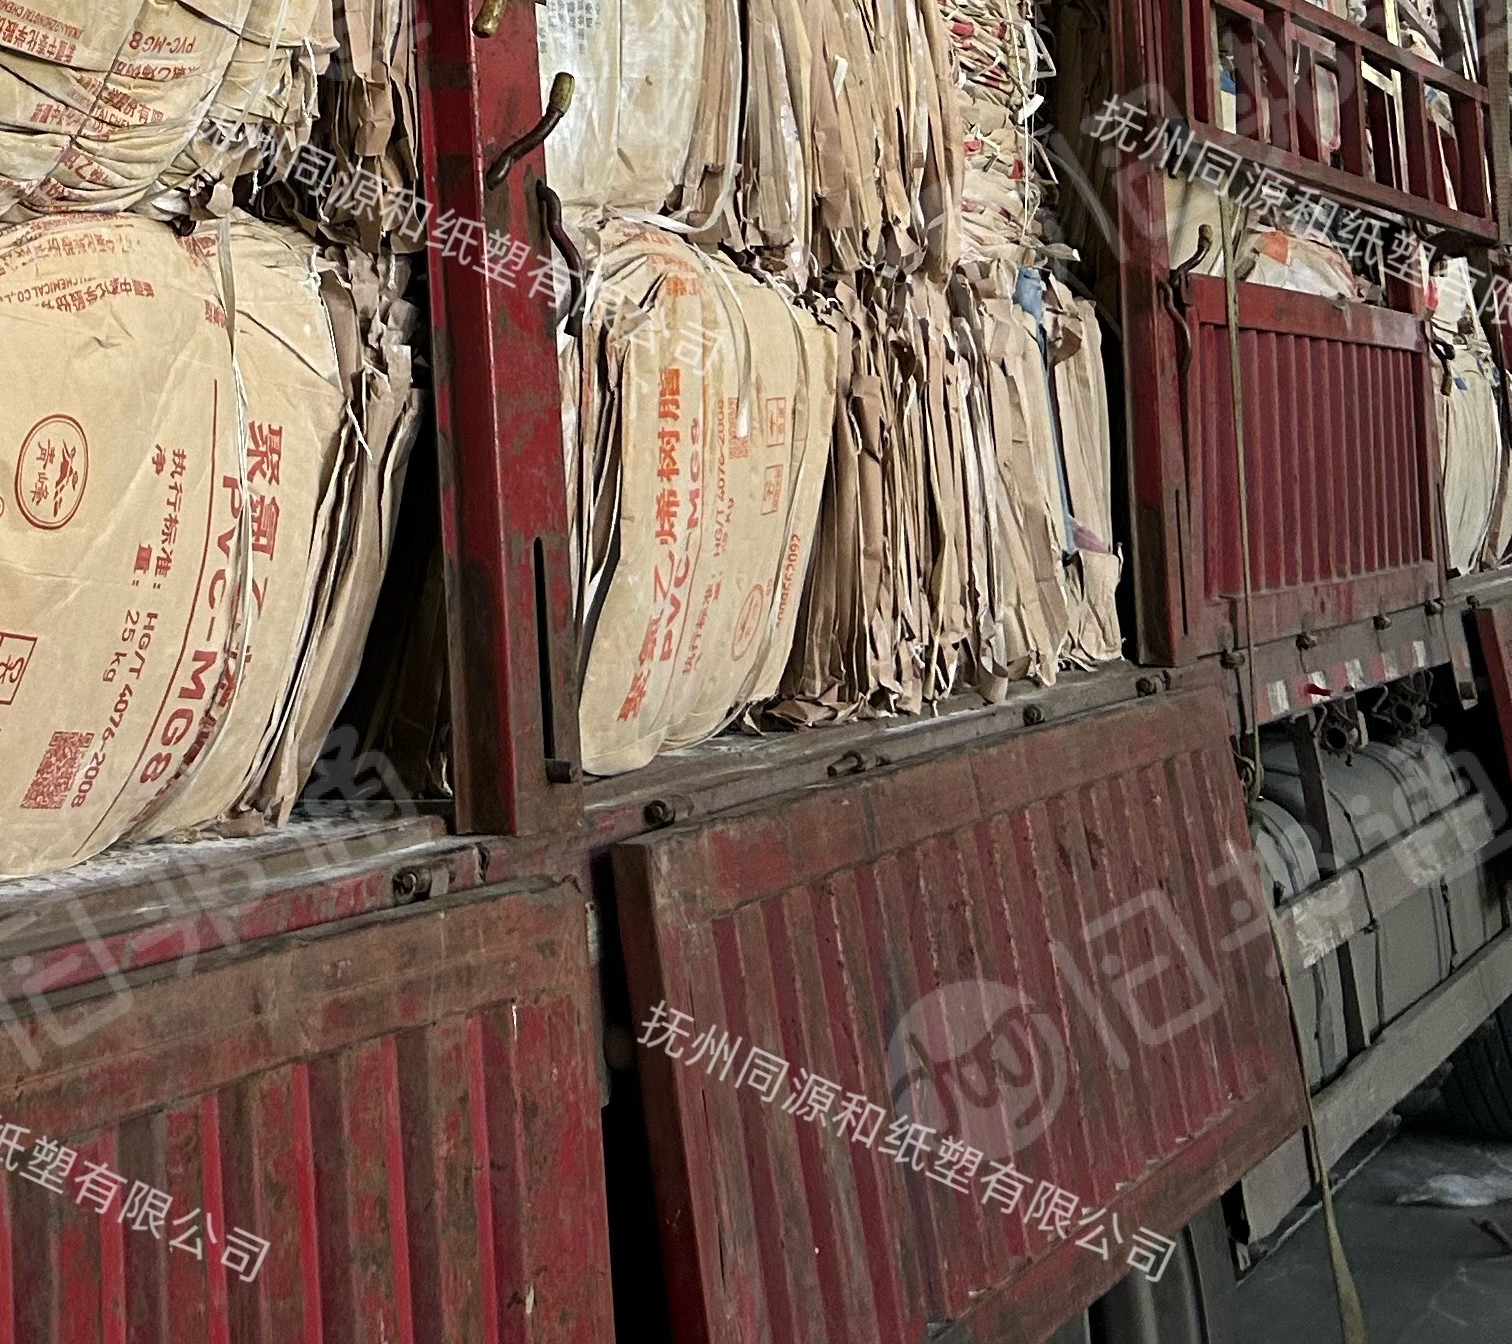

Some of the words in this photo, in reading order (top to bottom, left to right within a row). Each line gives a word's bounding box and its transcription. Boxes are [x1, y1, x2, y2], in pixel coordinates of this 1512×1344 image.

[128, 30, 198, 54] PVC-MG8
[152, 448, 187, 591] 执行标准：
[616, 366, 681, 723] 聚氯乙烯树脂
[712, 509, 728, 558] HG/T
[120, 608, 142, 644] 25
[127, 612, 160, 679] HG/T
[139, 475, 243, 785] PVC-MG8
[100, 651, 127, 684] kg
[70, 682, 136, 810] 4076-2008
